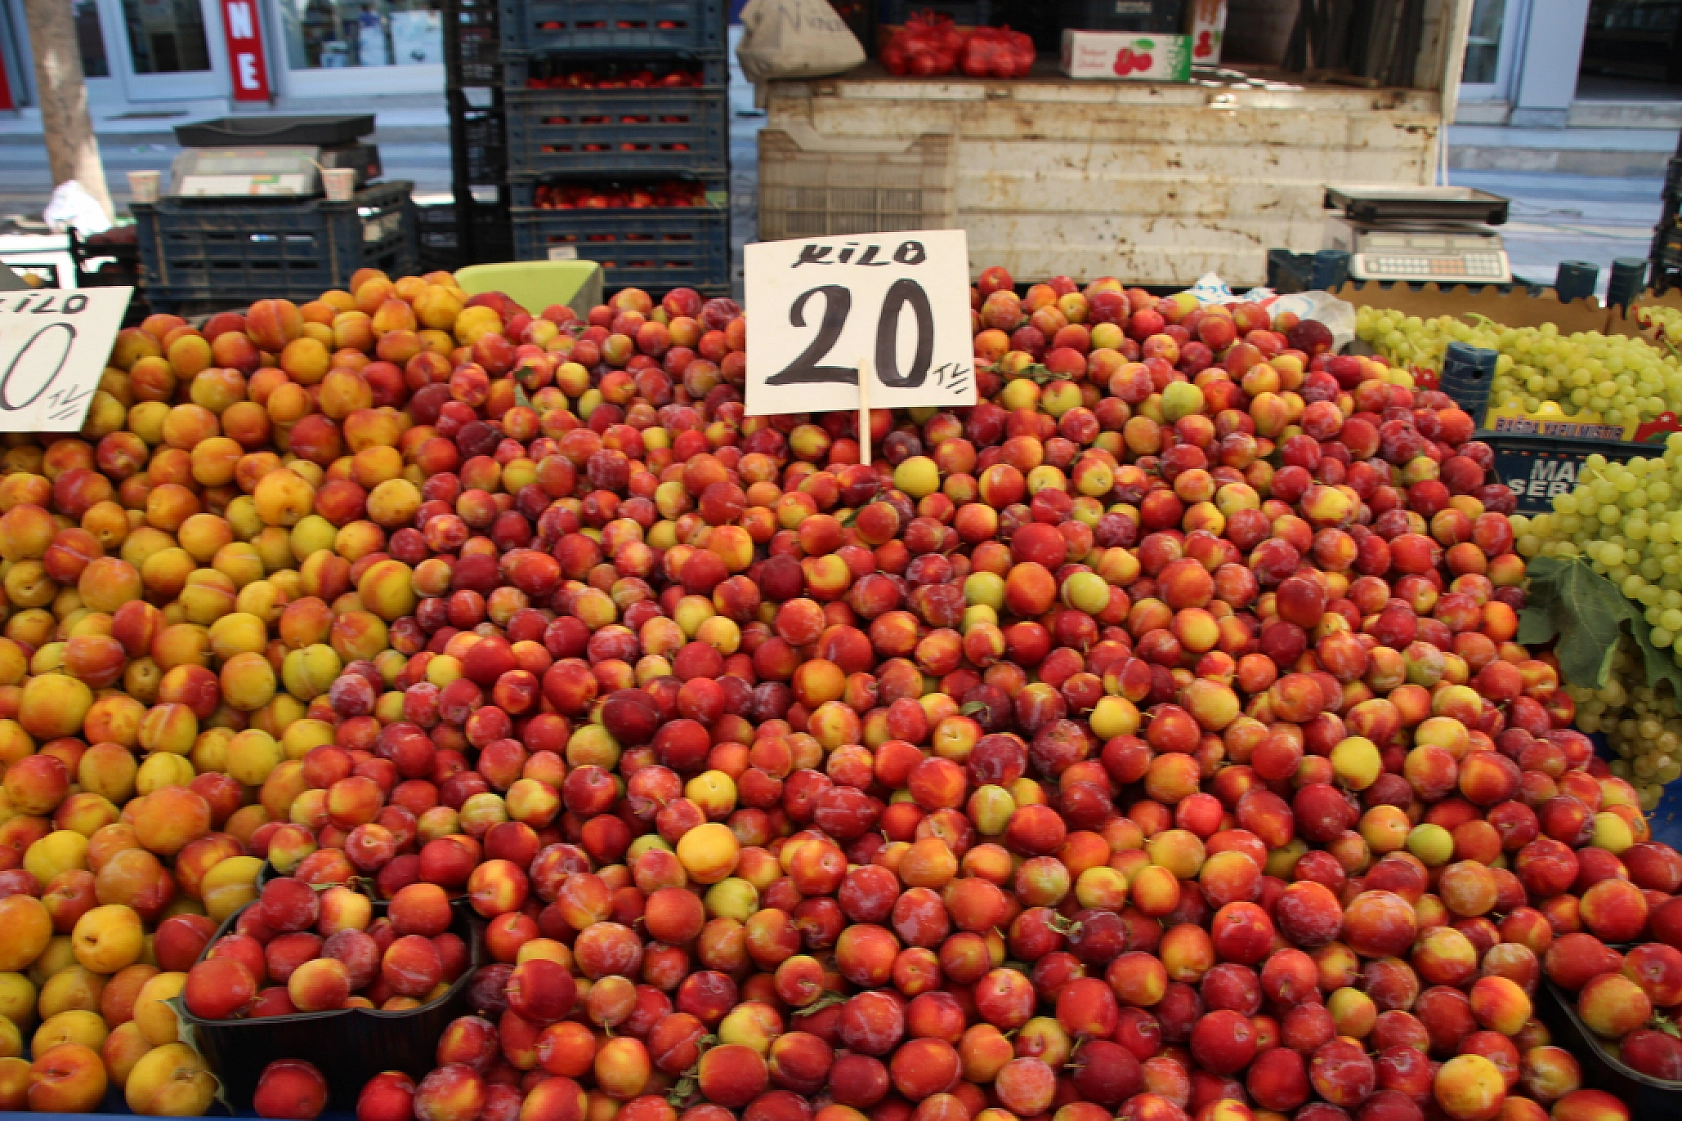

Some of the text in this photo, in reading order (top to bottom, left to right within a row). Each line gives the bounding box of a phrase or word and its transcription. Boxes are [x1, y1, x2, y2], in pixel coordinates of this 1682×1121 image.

[764, 278, 934, 387] 20
[1529, 459, 1587, 482] MA
[1507, 479, 1581, 498] SEB
